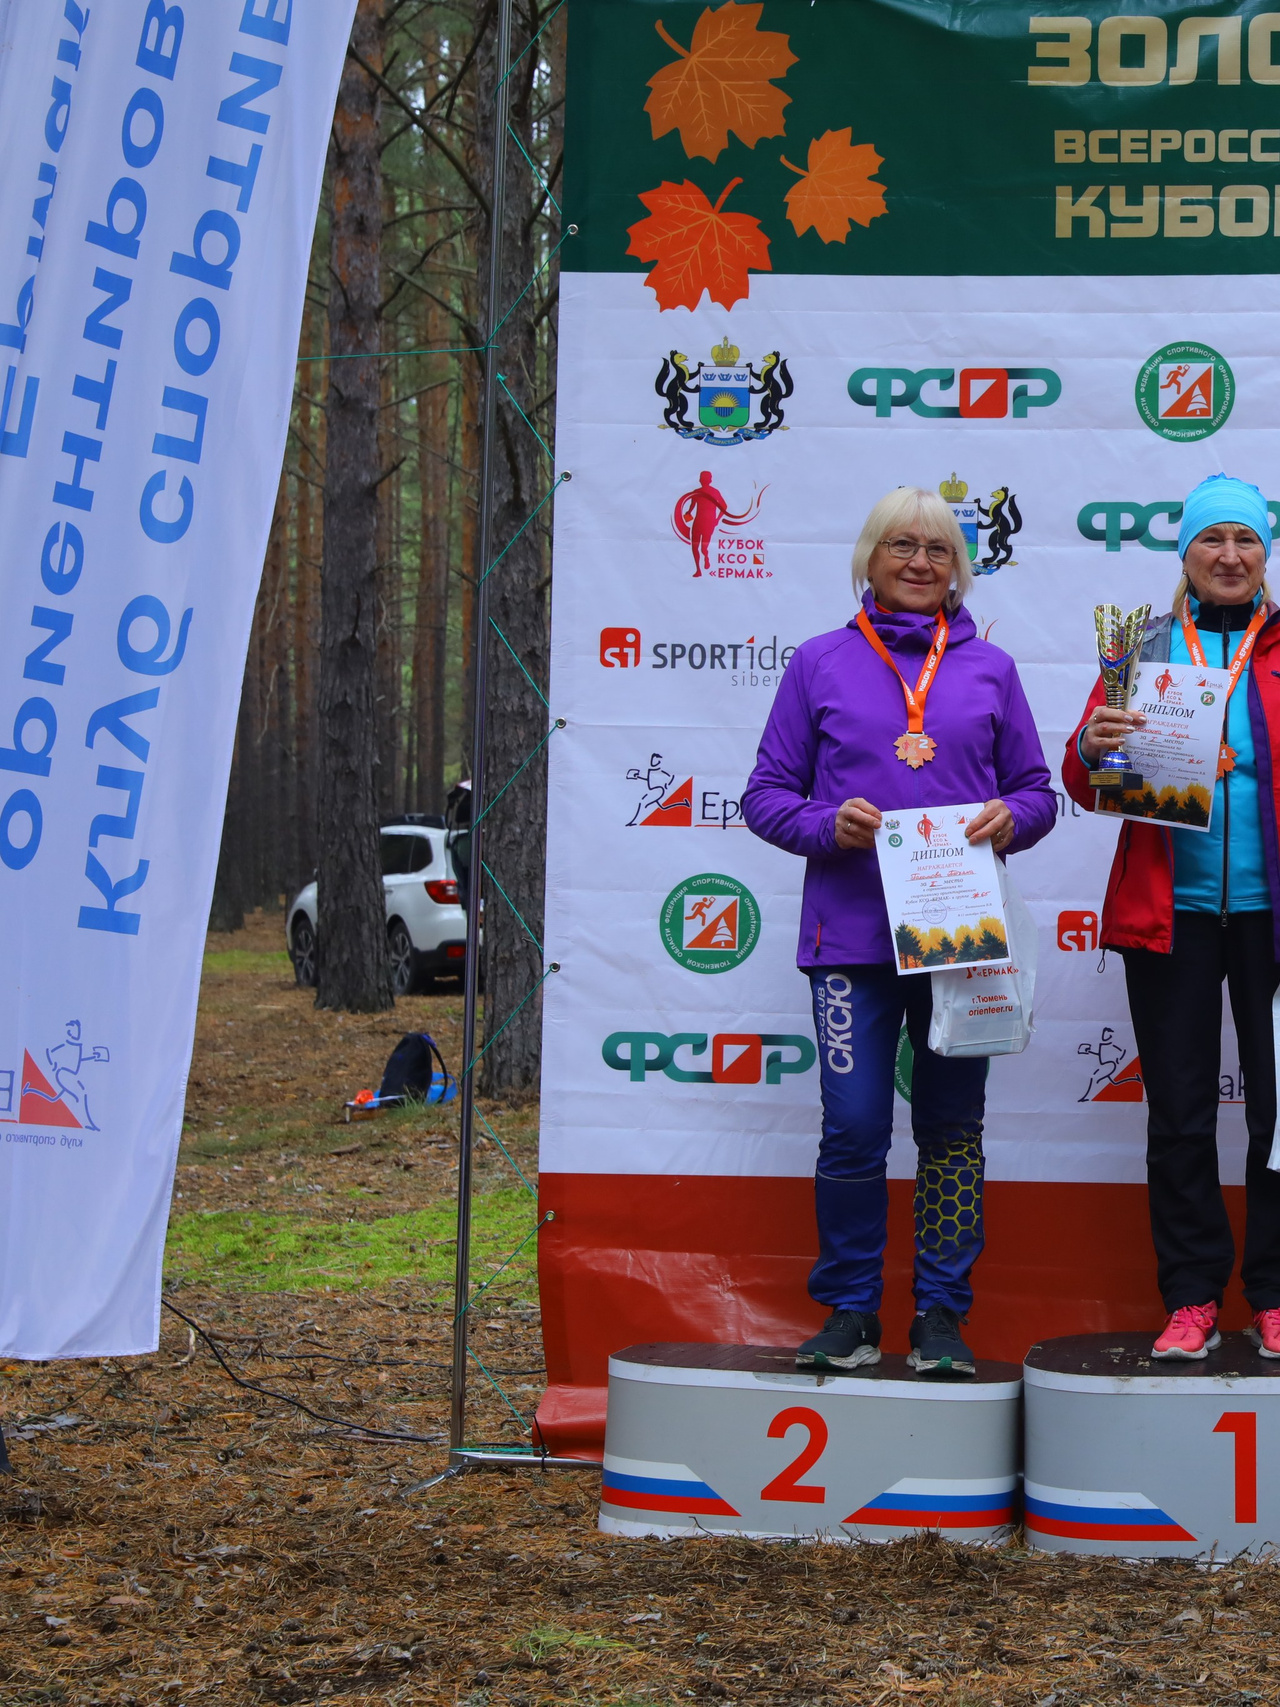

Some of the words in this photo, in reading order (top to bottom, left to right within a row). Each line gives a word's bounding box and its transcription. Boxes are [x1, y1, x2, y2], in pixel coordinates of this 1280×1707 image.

[1166, 346, 1216, 361] СПОРТИВНОГО
[1140, 356, 1163, 393] ФЕДЕРАЦИЯ
[1211, 364, 1230, 427] ОРИЕНТИРОВАНИЯ
[1140, 397, 1159, 427] ОБЛАСТИ
[1162, 427, 1207, 438] ТЮМЕНСКОЙ
[718, 538, 764, 550] КУБОК
[718, 553, 747, 565] КСО
[709, 567, 773, 579] «ЕРМАК»
[1138, 702, 1195, 719] ДИПЛОМ
[1145, 719, 1189, 730] АГРАЖДАЕТСЯ
[918, 738, 928, 749] 2
[911, 847, 965, 862] ДИПЛОМ
[692, 878, 742, 894] СПОРТИВНОГО
[665, 886, 688, 923] ФЕДЕРАЦИЯ
[735, 897, 756, 959] ОРИЕНТИРОВАНИЯ
[665, 928, 683, 958] ОБЛАСТИ
[687, 958, 731, 970] ТЮМЕНСКОЙ
[976, 966, 1019, 979] «ЕРМАК»
[971, 993, 1008, 1005] г.Тюмень
[968, 1003, 1014, 1017] orienteer.ru
[760, 1406, 829, 1504] 2
[1211, 1410, 1257, 1524] 1
